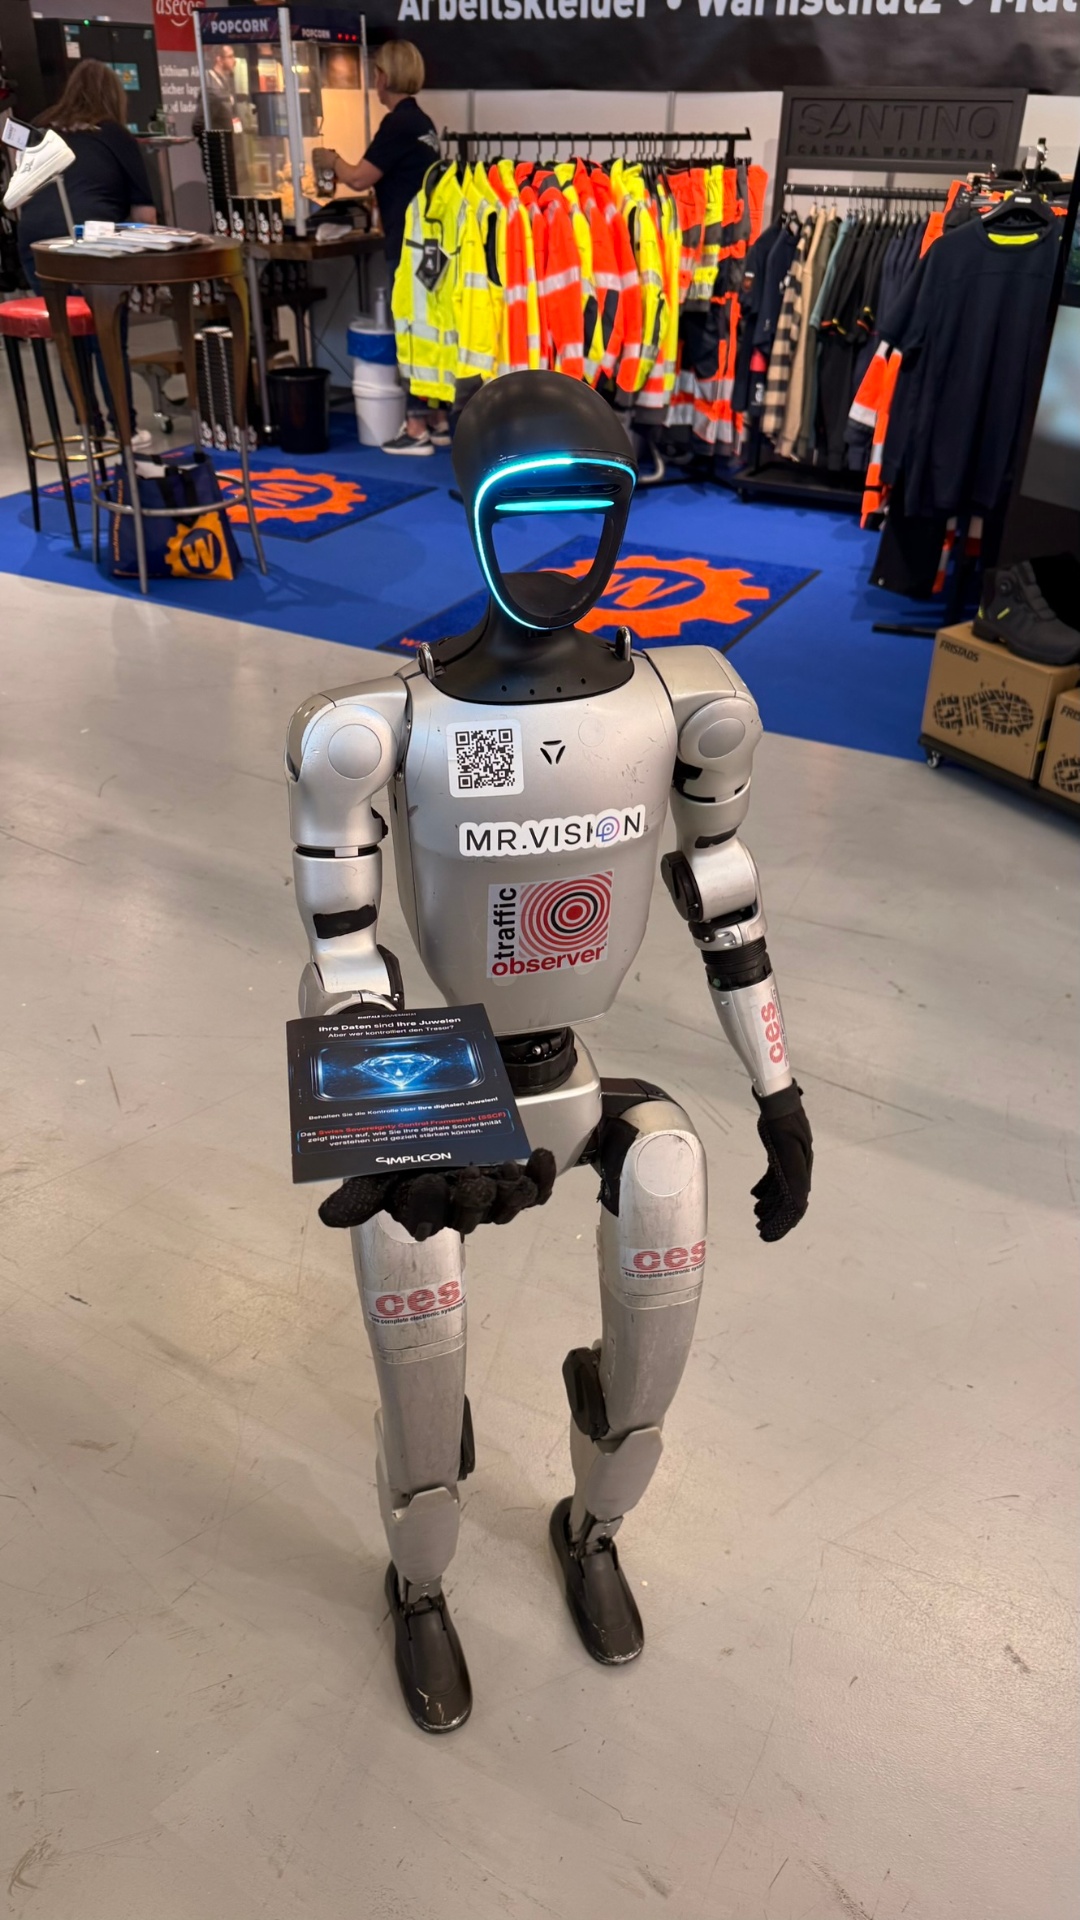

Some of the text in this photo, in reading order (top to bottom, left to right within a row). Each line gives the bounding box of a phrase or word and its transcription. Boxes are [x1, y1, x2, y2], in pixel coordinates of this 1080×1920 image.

[210, 18, 268, 34] POPCORN
[301, 28, 331, 39] POPCORN
[798, 102, 1001, 142] SANTINO
[798, 144, 994, 160] CASUAL WORKWEAR
[182, 533, 214, 569] W
[940, 640, 979, 662] FRISTADS
[466, 812, 641, 851] MR.VISION
[493, 887, 517, 960] traffic
[491, 946, 605, 976] observer
[365, 1028, 407, 1036] kontrolliert
[418, 1017, 461, 1026] Juwelen
[761, 1002, 784, 1064] ces
[433, 1102, 465, 1110] digitalen
[318, 1128, 344, 1136] Swiss
[345, 1124, 396, 1133] Sovereignty
[430, 1116, 476, 1125] Framework
[478, 1111, 507, 1121] (SSCF)
[329, 1132, 353, 1140] Ihnen
[420, 1125, 450, 1133] digitale
[451, 1119, 502, 1130] Souveränität
[329, 1138, 371, 1147] verstehen
[390, 1134, 418, 1142] gezielt
[450, 1128, 484, 1136] können.
[375, 1152, 452, 1165] SIMPLICON
[633, 1240, 706, 1271] ces
[664, 1269, 691, 1277] electronic
[375, 1281, 461, 1316] ces
[380, 1317, 409, 1325] complete
[410, 1311, 440, 1321] electronic
